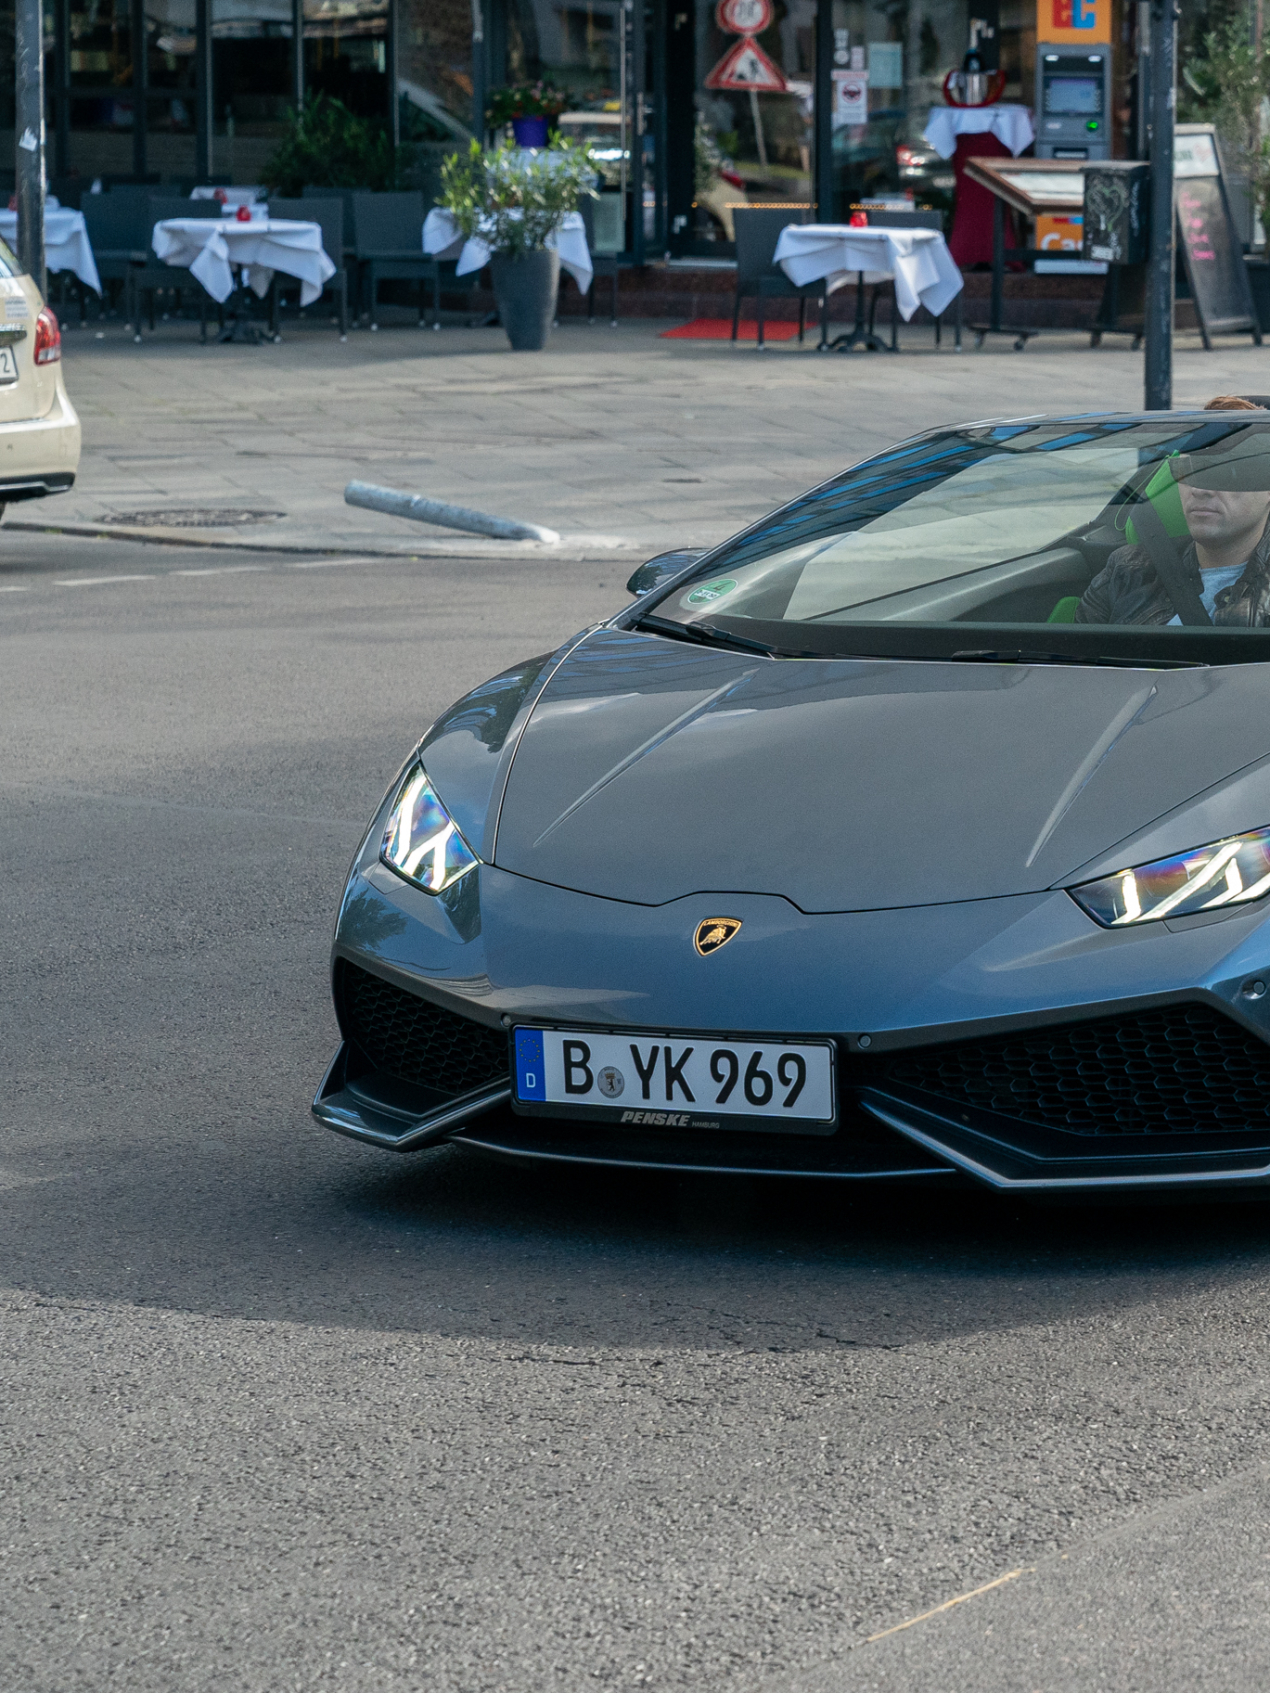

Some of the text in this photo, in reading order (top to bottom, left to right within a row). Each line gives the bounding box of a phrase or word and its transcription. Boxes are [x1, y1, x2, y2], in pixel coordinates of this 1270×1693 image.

[526, 1072, 537, 1088] D
[562, 1039, 594, 1094] B
[629, 1044, 697, 1102] YK
[709, 1049, 807, 1108] 969
[620, 1110, 691, 1127] PENSKE
